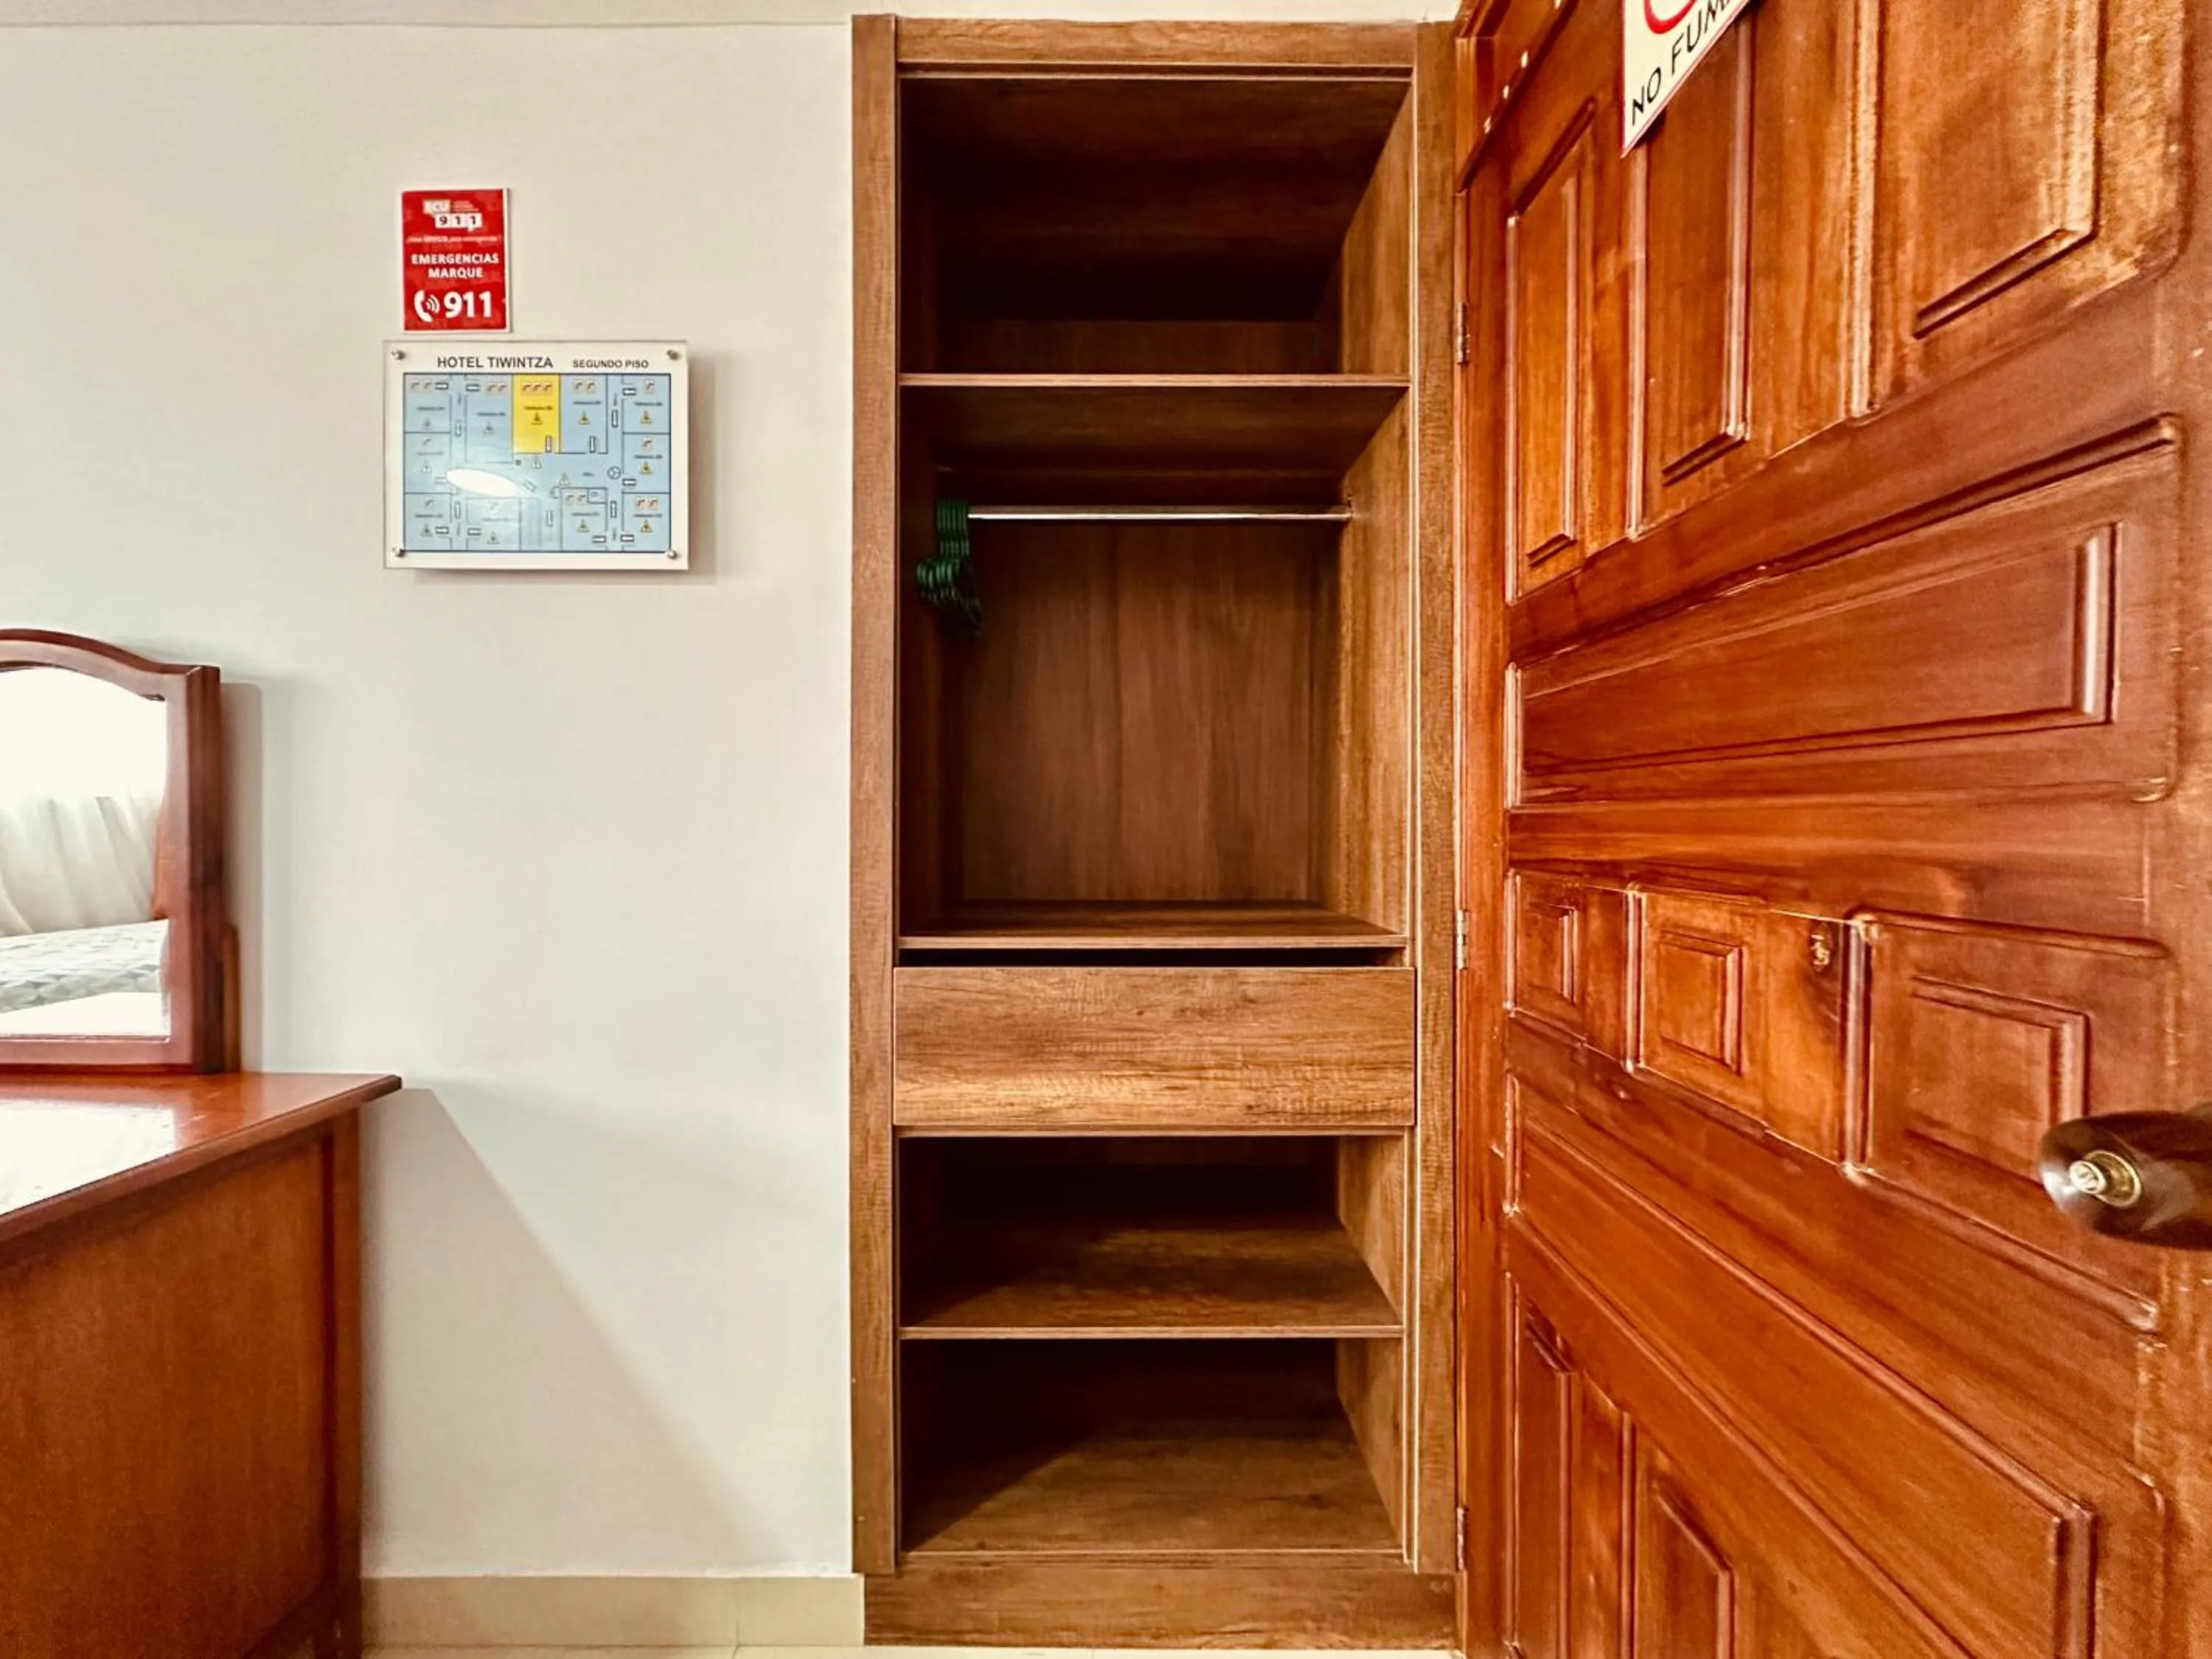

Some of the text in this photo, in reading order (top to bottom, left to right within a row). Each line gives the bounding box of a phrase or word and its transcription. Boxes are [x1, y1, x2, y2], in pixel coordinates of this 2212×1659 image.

[1632, 0, 1730, 125] NO FUM
[439, 215, 476, 226] 911
[411, 253, 499, 265] EMERGENCIAS
[428, 268, 484, 279] MARQUE
[444, 291, 492, 319] 911
[437, 356, 553, 368] HOTEL TIWINTZA
[573, 359, 649, 369] SEGUNDO PISO
